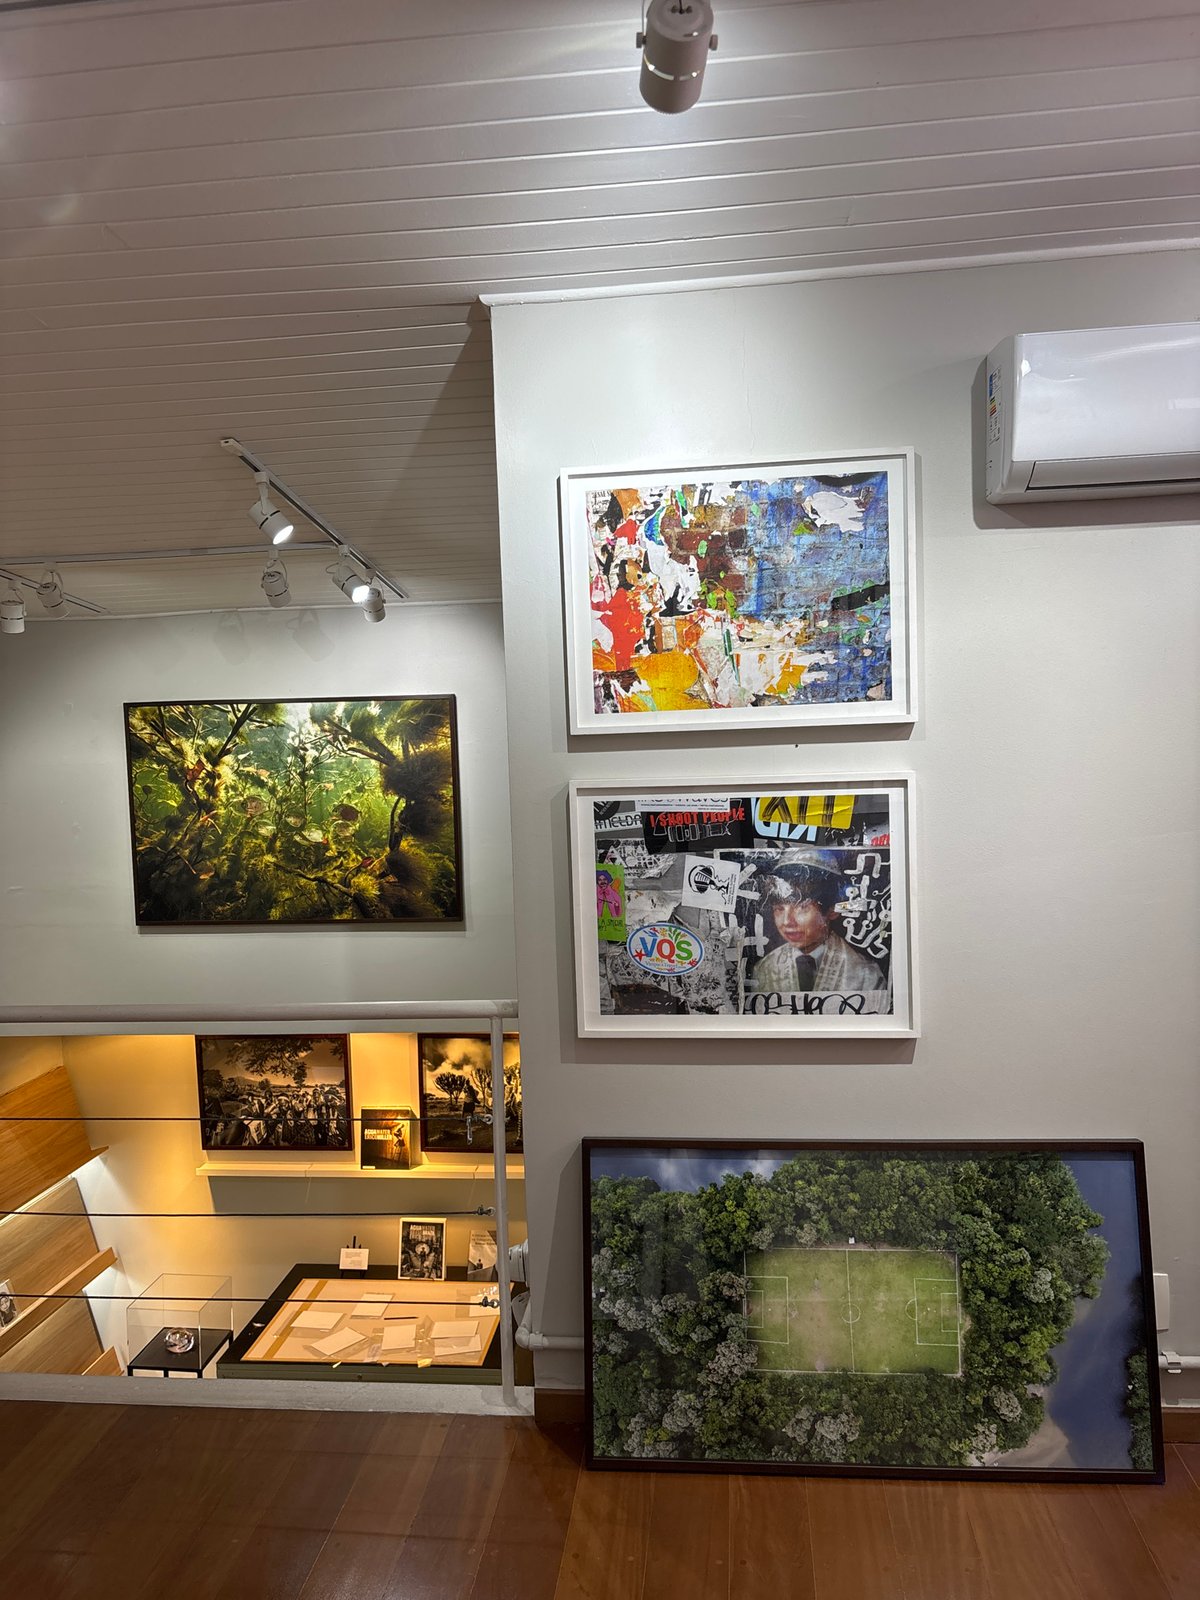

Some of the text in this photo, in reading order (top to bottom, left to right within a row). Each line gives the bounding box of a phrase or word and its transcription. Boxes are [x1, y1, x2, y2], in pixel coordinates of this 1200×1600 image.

[660, 811, 698, 827] SHOOT
[703, 807, 745, 824] PEOPLE
[639, 936, 694, 964] VQS
